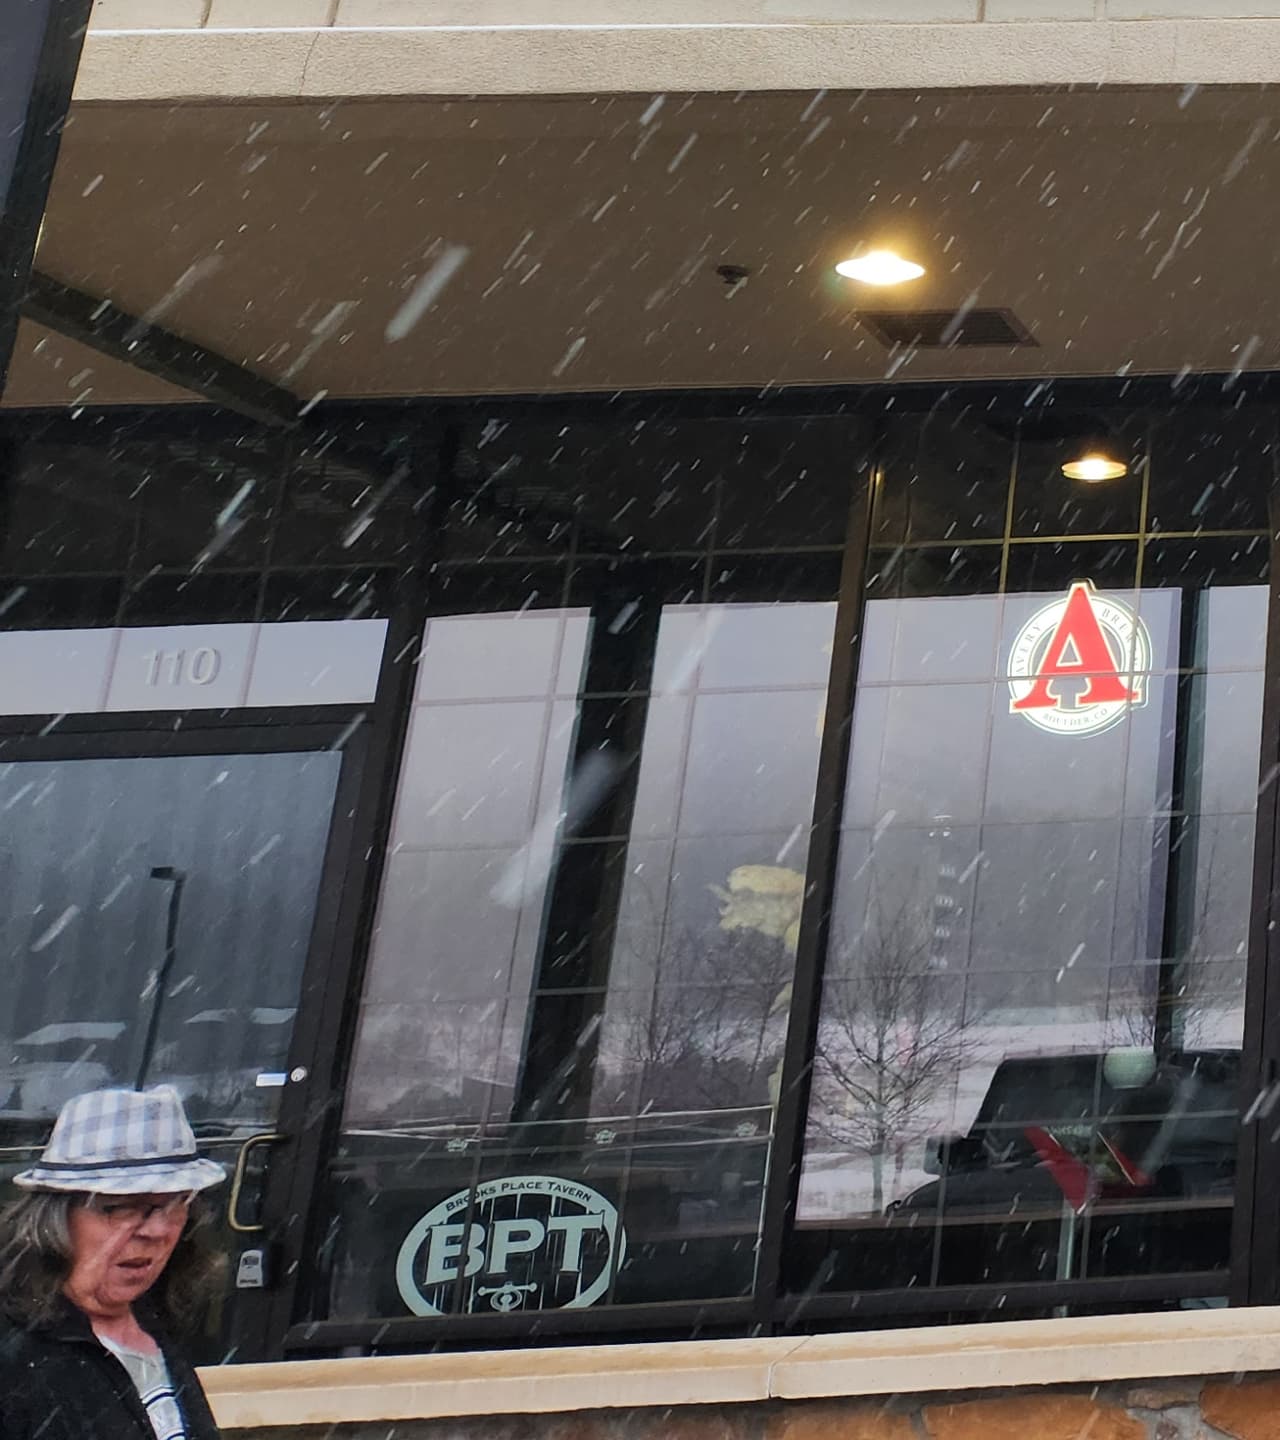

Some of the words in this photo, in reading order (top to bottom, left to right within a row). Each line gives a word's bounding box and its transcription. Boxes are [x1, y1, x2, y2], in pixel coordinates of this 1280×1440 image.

[142, 647, 222, 687] 110
[501, 1181, 543, 1192] PLACE
[547, 1180, 593, 1203] TAVERN
[423, 1212, 605, 1286] BPT
